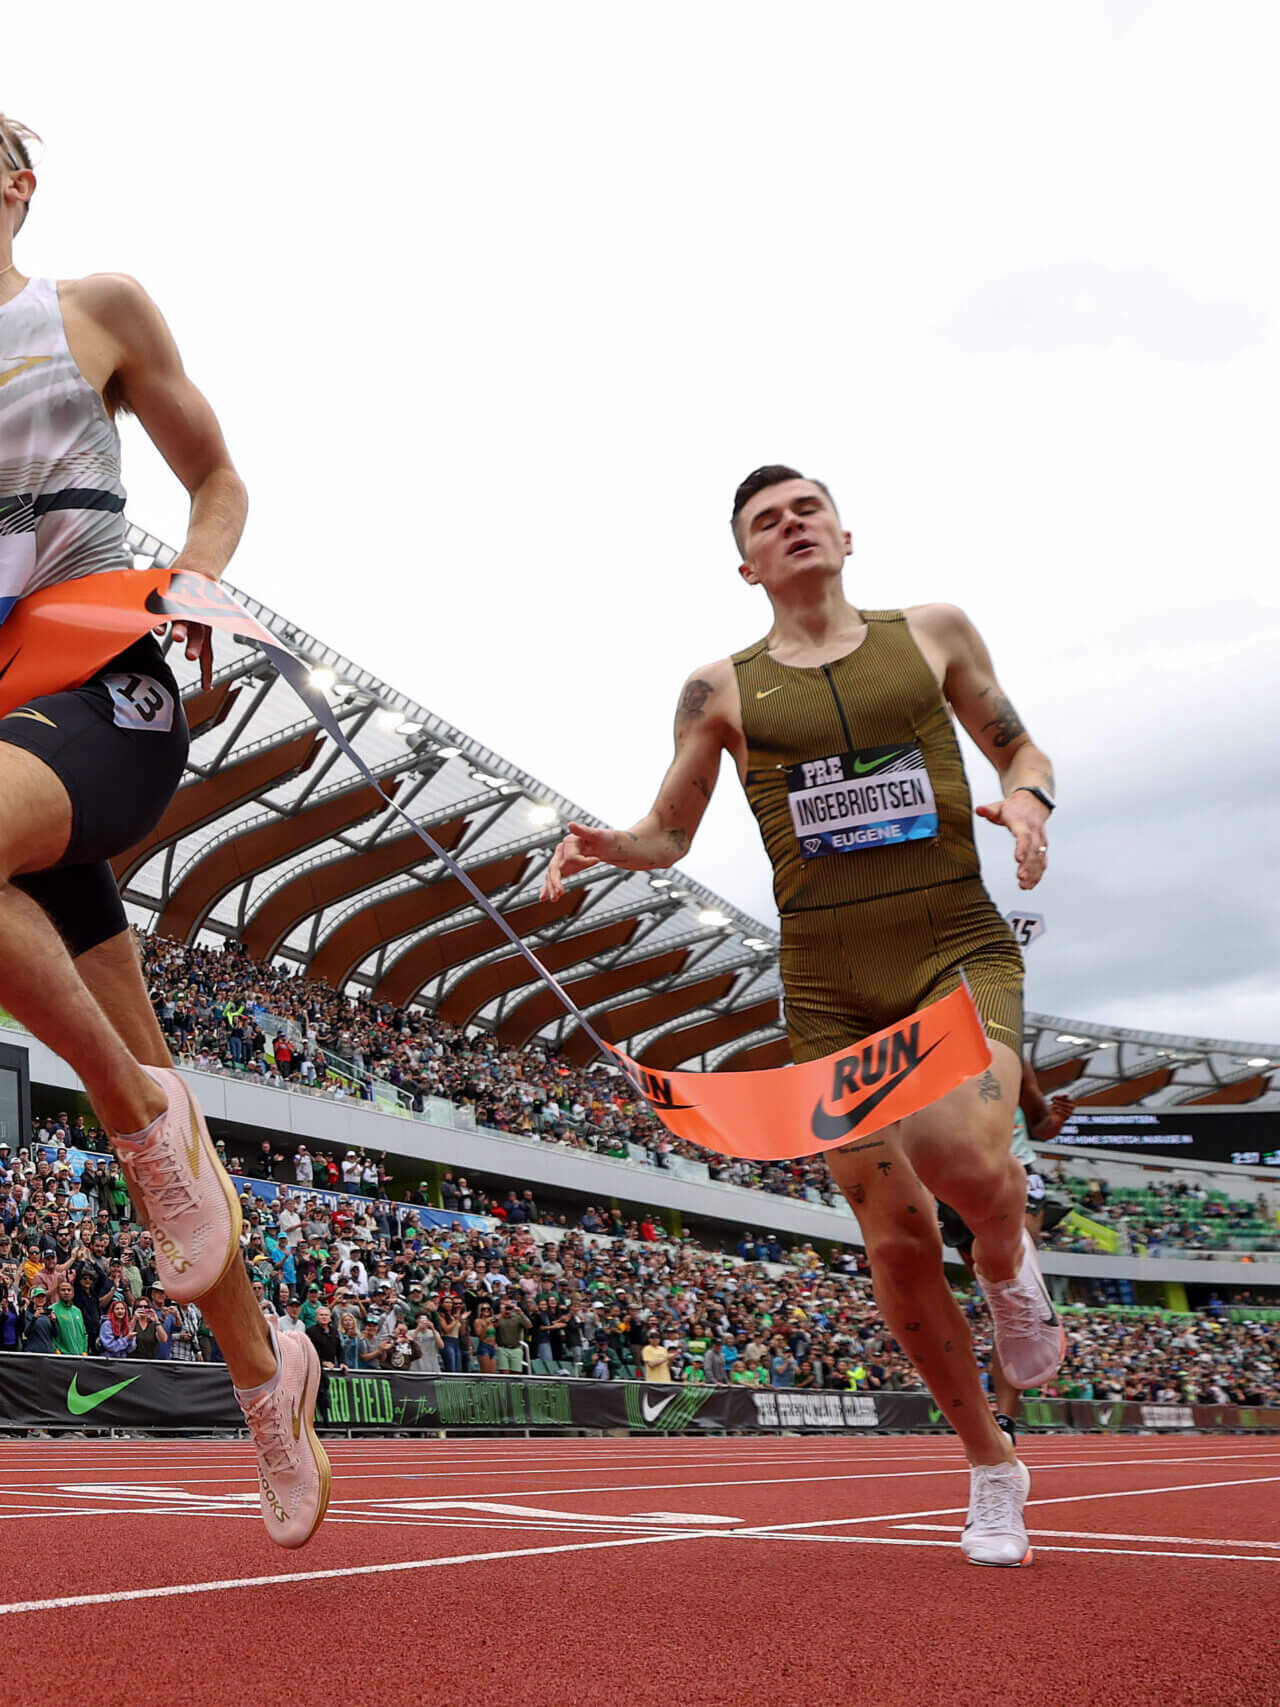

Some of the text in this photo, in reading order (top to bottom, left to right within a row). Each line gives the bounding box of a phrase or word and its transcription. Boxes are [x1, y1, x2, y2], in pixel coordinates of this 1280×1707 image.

[169, 572, 237, 605] RU
[117, 675, 164, 723] 13
[801, 756, 845, 788] PRE
[796, 777, 926, 827] INGEBRIGTSEN
[832, 824, 903, 848] EUGENE
[831, 1021, 921, 1102] RUN
[153, 1222, 193, 1274] OOKS
[352, 1377, 394, 1423] FIELD
[258, 1466, 291, 1523] OOKS
